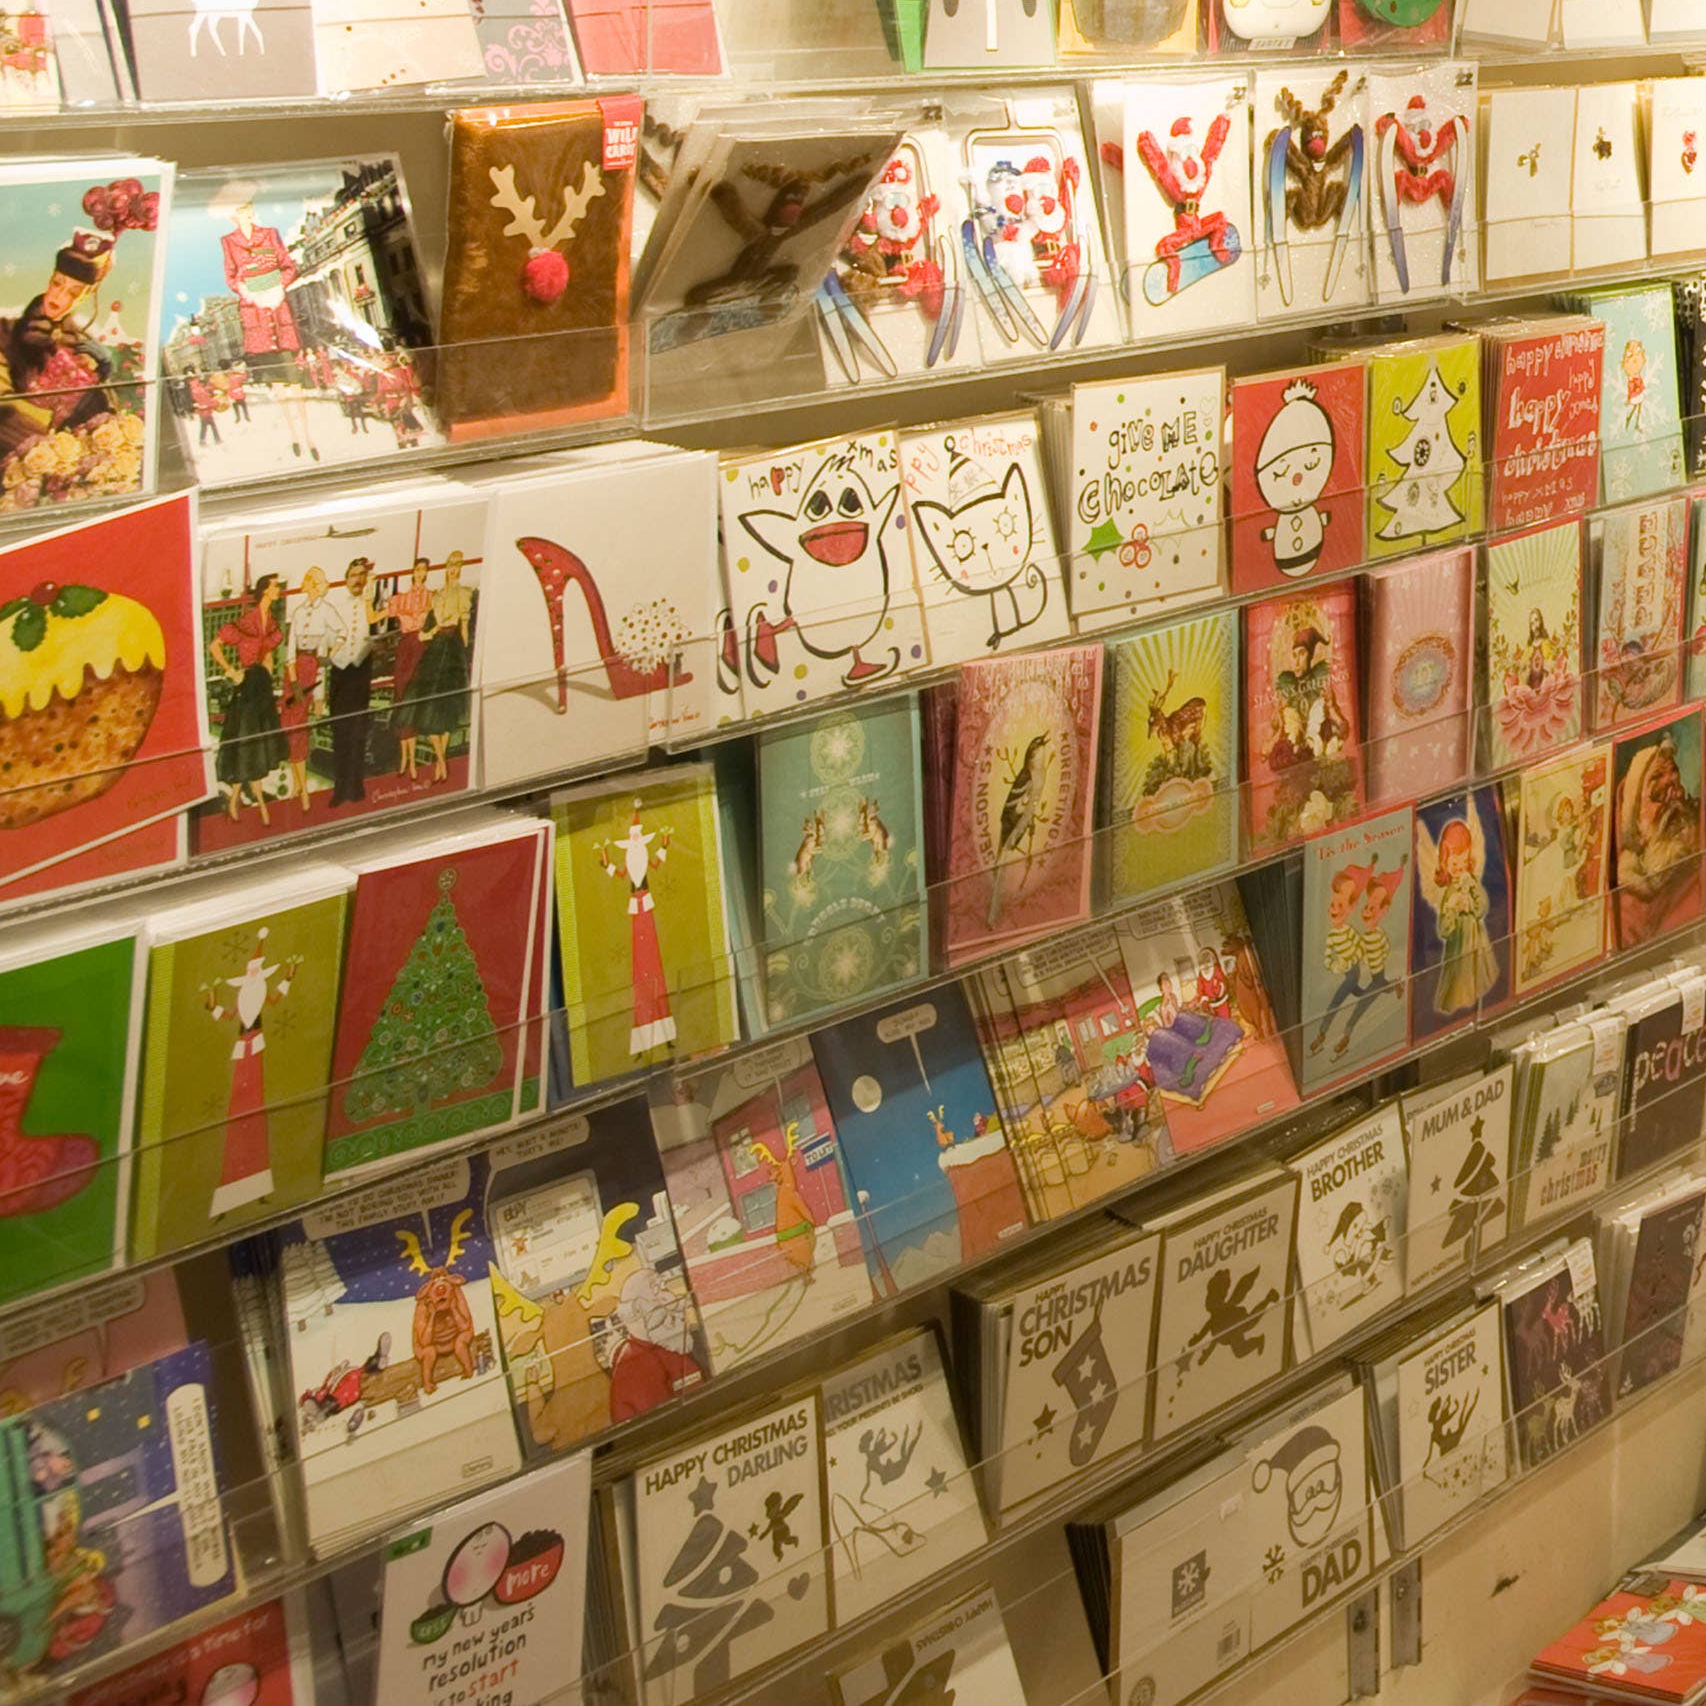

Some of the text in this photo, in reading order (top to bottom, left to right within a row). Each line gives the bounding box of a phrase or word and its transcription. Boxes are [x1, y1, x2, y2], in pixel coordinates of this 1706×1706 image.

[1506, 341, 1554, 377] happy
[1160, 410, 1199, 453] ME
[1507, 385, 1572, 436] happy
[958, 426, 1034, 458] christmas
[1503, 429, 1598, 479] christmas
[748, 439, 898, 501] happy xmas
[1364, 823, 1406, 845] Season
[1421, 1079, 1506, 1142] MUM & DAD
[805, 1150, 819, 1162] TO
[1306, 1124, 1384, 1179] HAPPY CHRISTMAS
[1310, 1139, 1386, 1203] BROTHER
[1539, 1161, 1600, 1207] christmas
[1177, 1213, 1280, 1284] DAUGHTER
[1193, 1206, 1268, 1251] HAPPY CHRISTMAS
[1018, 1257, 1151, 1340] CHRISTMAS
[1035, 1281, 1068, 1304] HAPPY
[1018, 1320, 1073, 1369] SON
[1423, 1341, 1478, 1397] SISTER
[822, 1353, 923, 1423] RISTMAS
[644, 1407, 809, 1497] HAPPY CHRISTMAS
[726, 1435, 809, 1489] DARLING
[505, 1560, 550, 1596] more
[1301, 1538, 1362, 1609] DAD
[451, 1630, 488, 1656] new
[915, 1616, 963, 1652] CHRISTMAS
[428, 1632, 527, 1691] resolution
[467, 1659, 518, 1697] start
